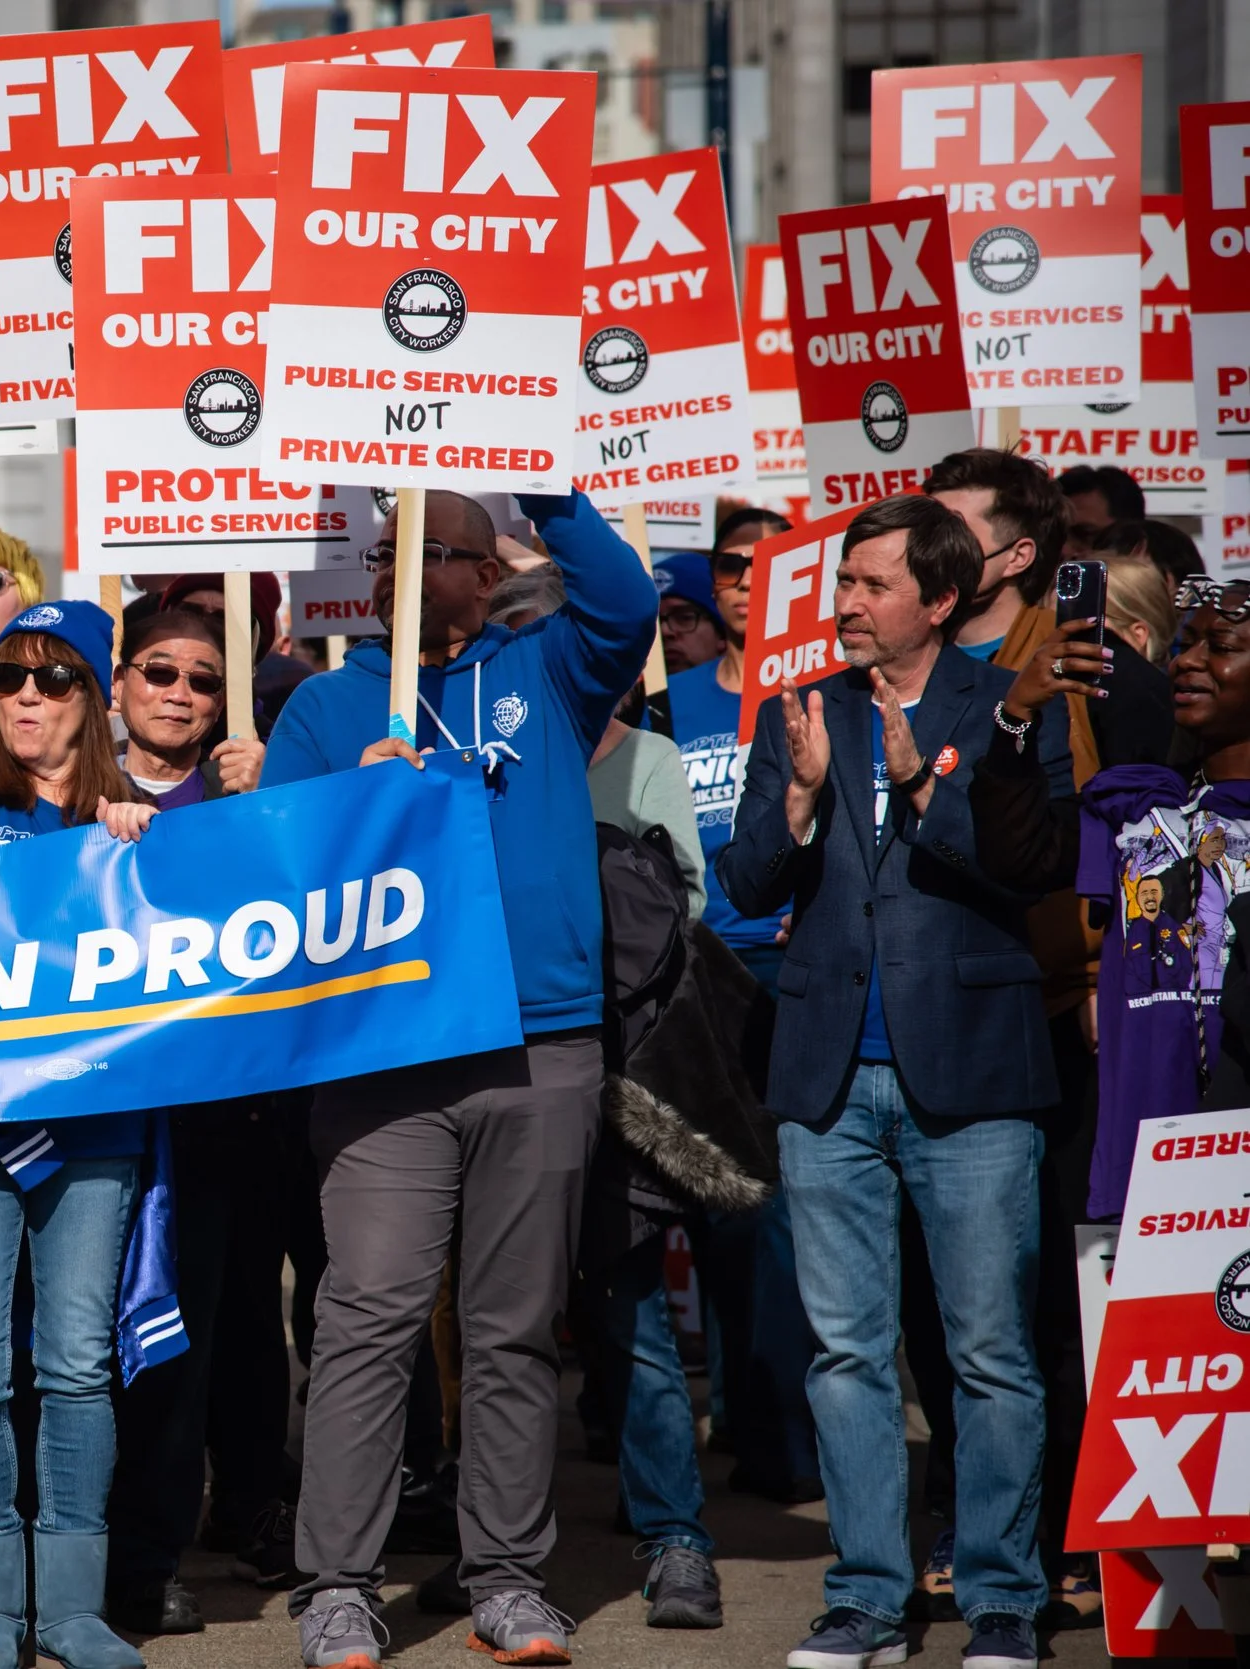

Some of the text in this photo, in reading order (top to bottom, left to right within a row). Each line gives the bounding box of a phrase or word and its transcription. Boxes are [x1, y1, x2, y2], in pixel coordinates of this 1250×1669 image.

[901, 76, 1116, 170] FIX
[311, 89, 566, 198] FIX
[1005, 175, 1116, 211] CITY
[303, 209, 558, 254] OUR CITY
[585, 170, 707, 270] IX
[973, 229, 1036, 258] SAN FRANCISCO
[797, 218, 941, 320] FIX
[974, 265, 1036, 292] CITY WORKERS
[389, 273, 462, 308] SAN FRANCISCO
[608, 267, 708, 307] CITY
[102, 313, 212, 348] OUR
[389, 317, 461, 348] CITY WORKERS
[988, 305, 1123, 328] SERVICES
[586, 330, 645, 361] SAN FRANCISCO
[807, 331, 871, 367] OUR
[876, 323, 944, 363] CITY
[975, 333, 1031, 365] NOT
[189, 372, 257, 405] SAN FRANCISCO
[284, 365, 558, 397] PUBLIC SERVICES
[589, 362, 646, 391] CITY WORKERS
[1027, 366, 1124, 388] GREED
[386, 402, 452, 436] NOT
[609, 394, 733, 428] SERVICES
[191, 414, 258, 443] CITY WORKERS
[753, 429, 805, 451] STA
[1150, 429, 1199, 456] UP
[279, 437, 554, 472] PRIVATE GREED
[600, 430, 651, 465] NOT
[571, 467, 639, 493] VATE
[646, 454, 740, 483] GREED
[104, 511, 347, 535] PUBLIC SERVICES
[642, 501, 700, 517] RVICES
[305, 600, 377, 620] PRIV
[759, 643, 826, 687] OUR
[693, 784, 734, 804] IKES
[68, 866, 426, 1003] PROUD
[93, 1062, 108, 1070] 146
[1138, 1206, 1250, 1237] RVICES
[1224, 1255, 1250, 1284] KERS
[1220, 1295, 1250, 1328] NCISCO
[1117, 1353, 1244, 1398] CITY
[1096, 1412, 1250, 1523] IX
